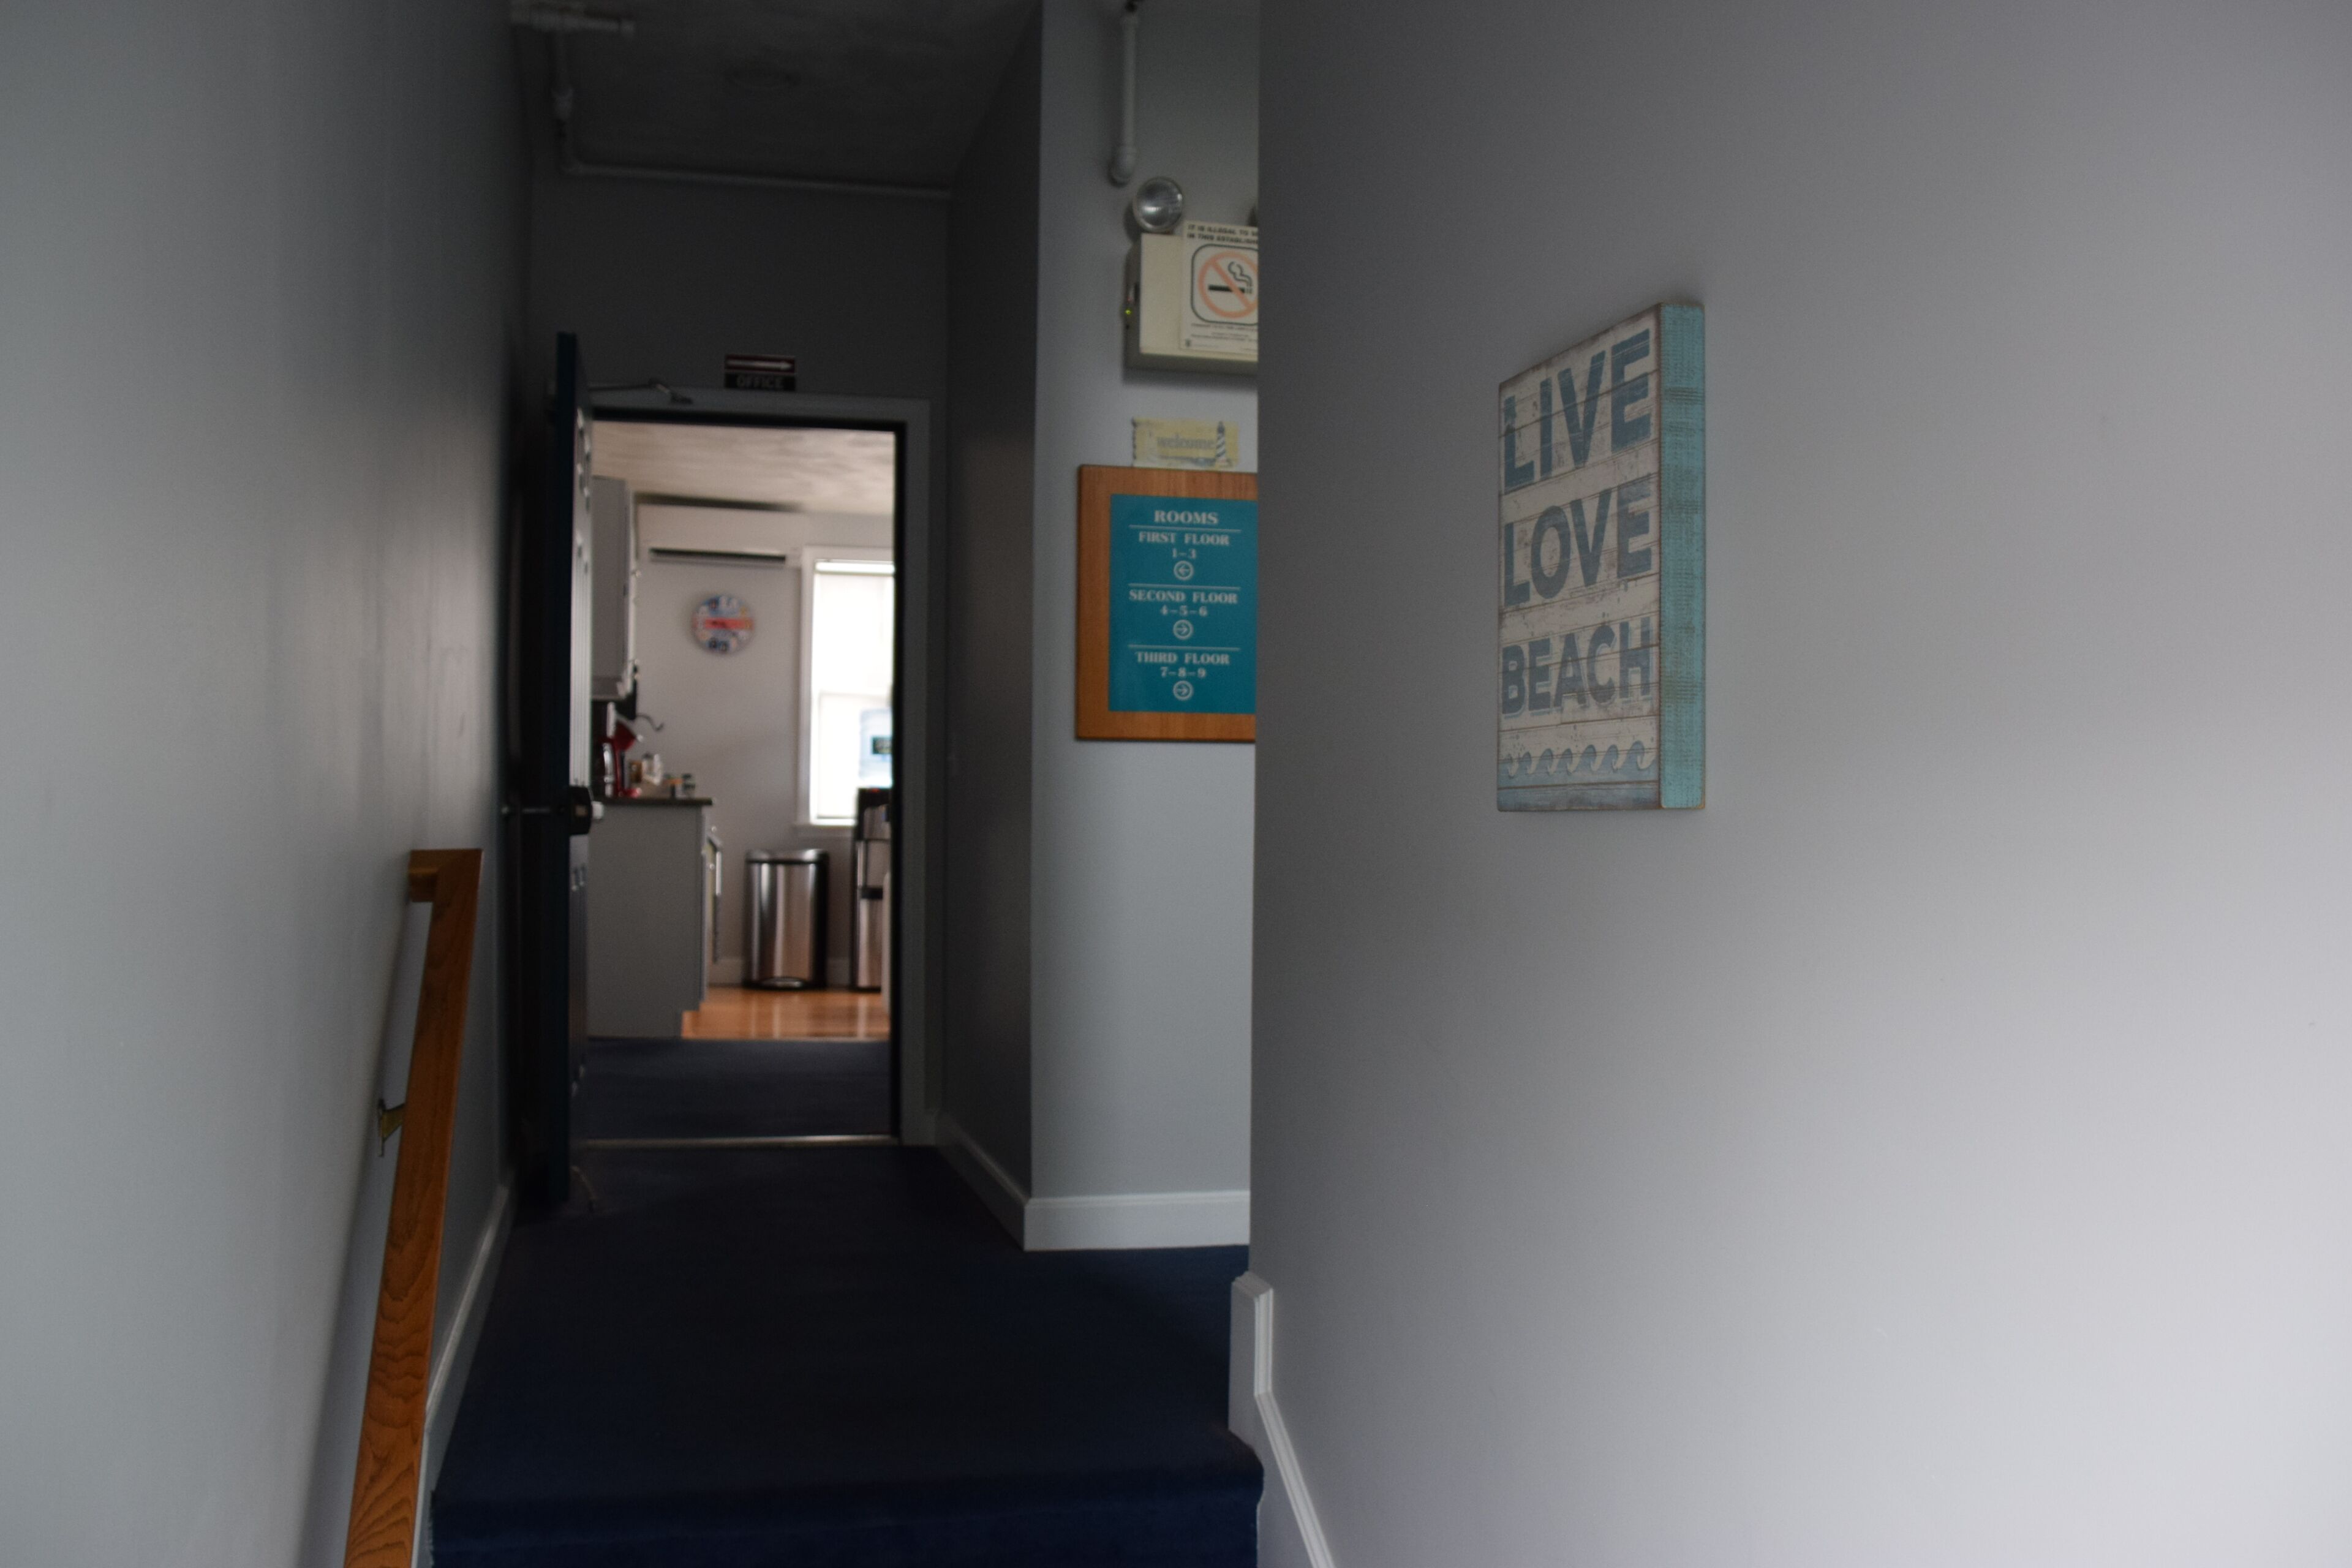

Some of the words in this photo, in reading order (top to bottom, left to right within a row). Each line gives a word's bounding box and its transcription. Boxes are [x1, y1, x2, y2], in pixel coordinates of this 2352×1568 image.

[736, 374, 784, 389] OFFICE
[1504, 328, 1651, 494] LIVE
[1154, 510, 1219, 525] ROOMS
[1138, 531, 1177, 543] FIRST
[1184, 532, 1230, 546] FLOOR
[1504, 481, 1652, 606] LOVE
[1129, 589, 1186, 603] SECOND
[1192, 591, 1238, 604] FLOOR
[1135, 651, 1178, 664] THIRD
[1184, 652, 1230, 665] FLOOR
[1502, 616, 1652, 719] BEACH
